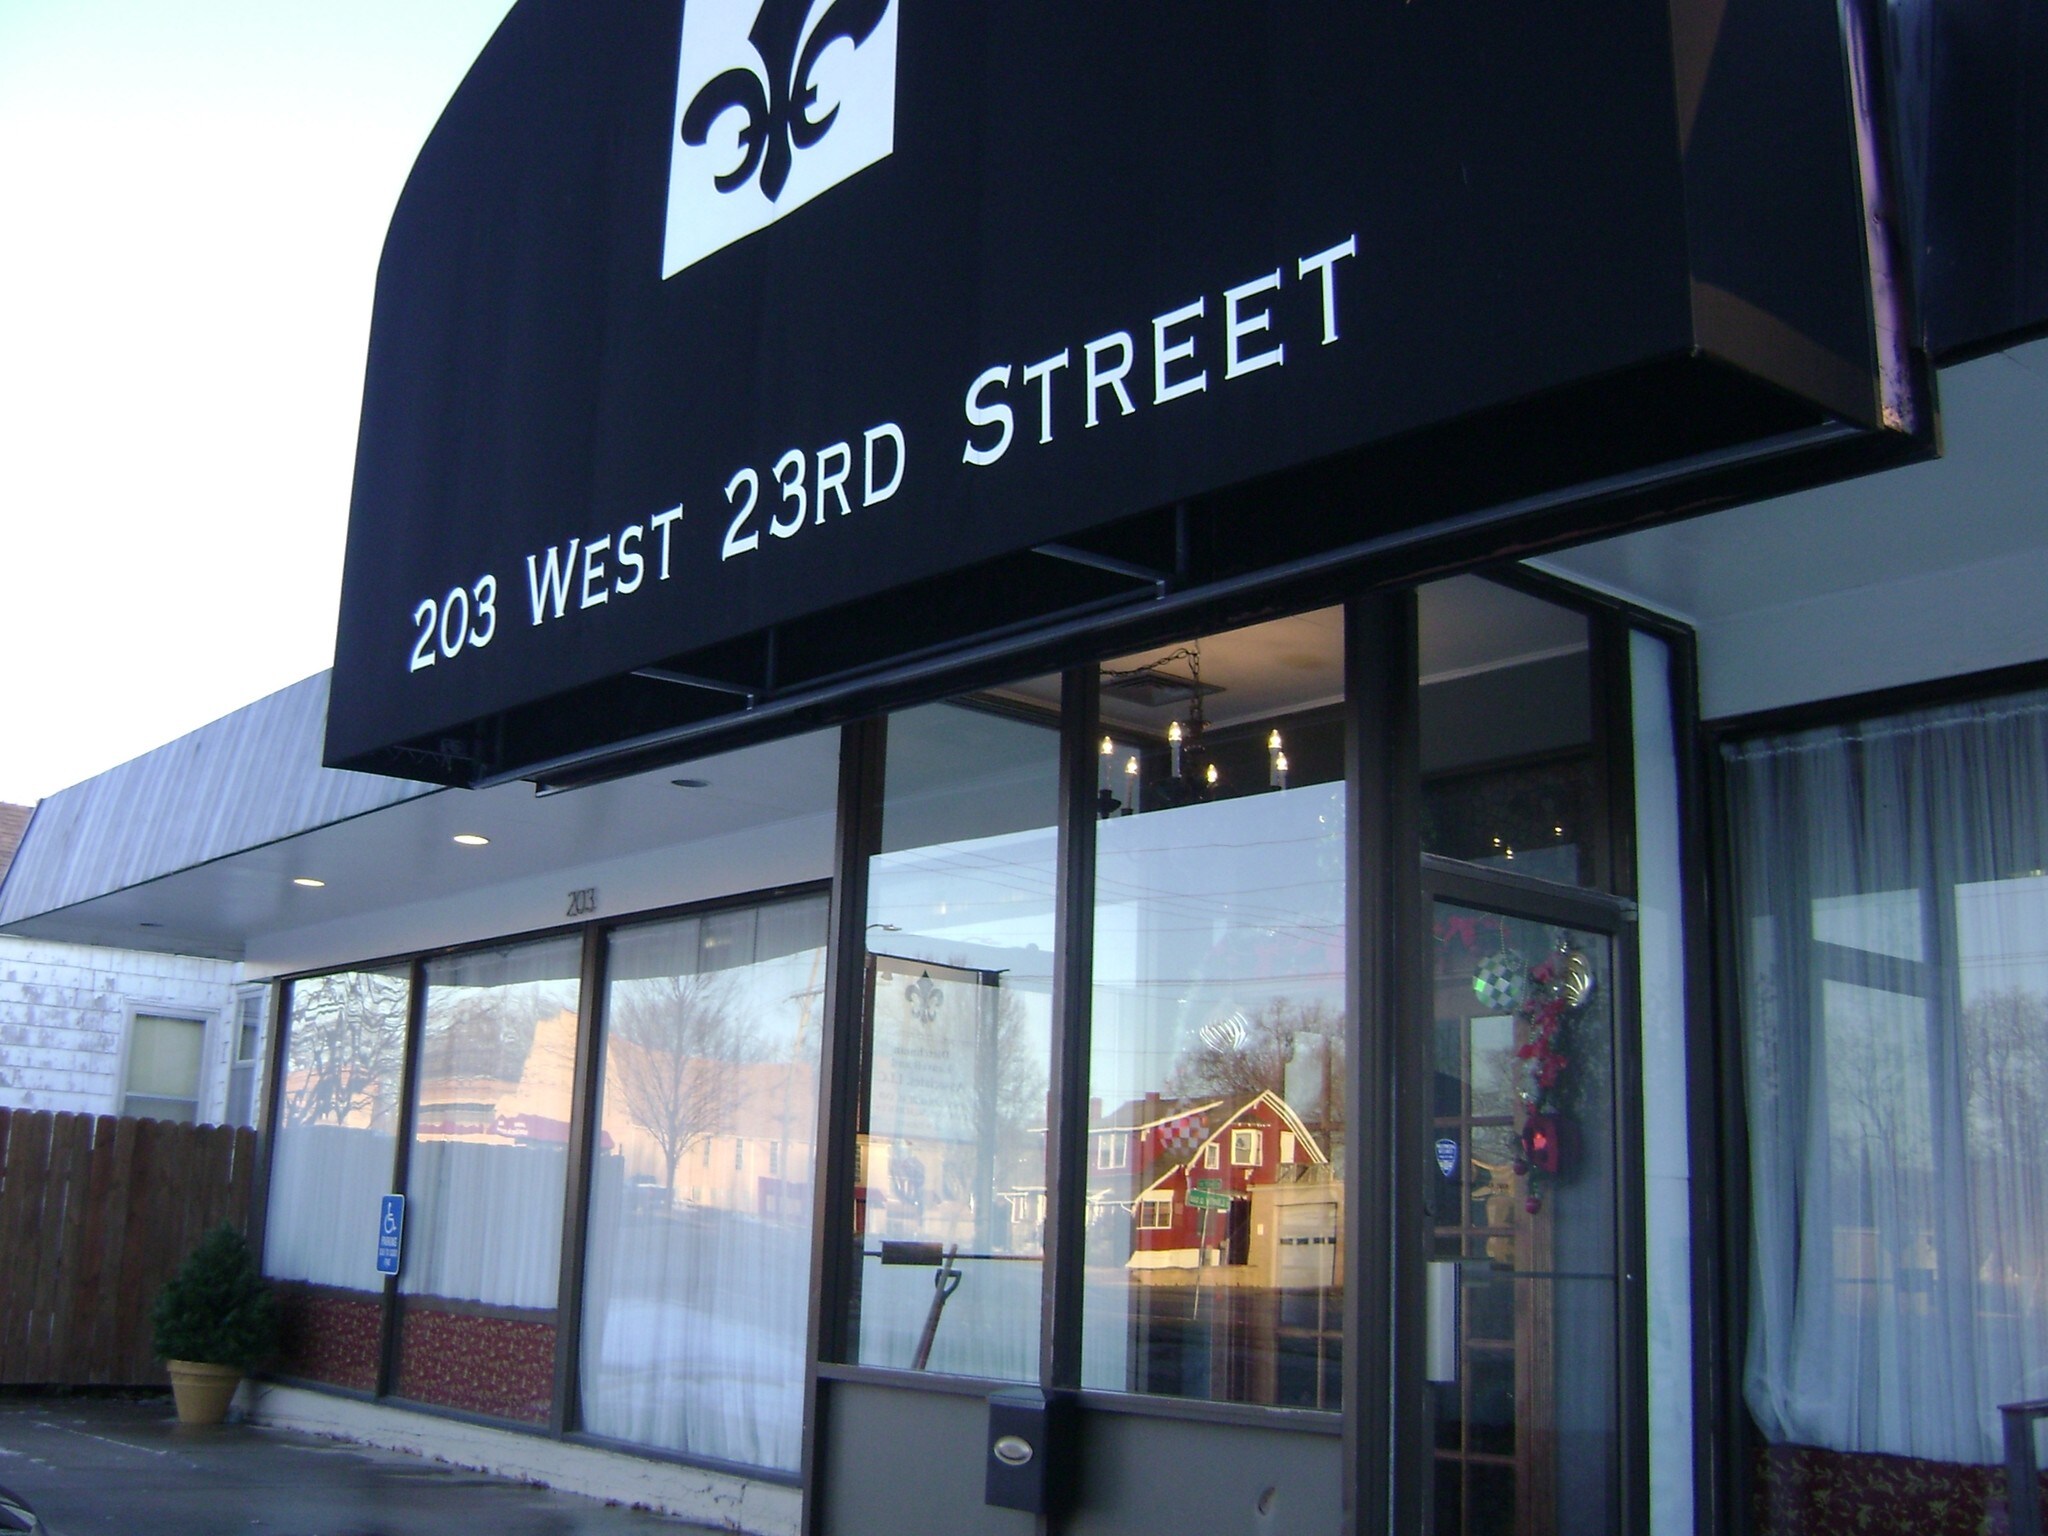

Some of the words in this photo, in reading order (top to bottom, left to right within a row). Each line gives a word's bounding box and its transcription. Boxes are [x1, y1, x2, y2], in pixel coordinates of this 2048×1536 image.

[408, 573, 498, 674] 203
[525, 502, 685, 627] WEST
[720, 421, 907, 563] 23RD
[961, 234, 1357, 467] STREET
[567, 888, 596, 916] 203
